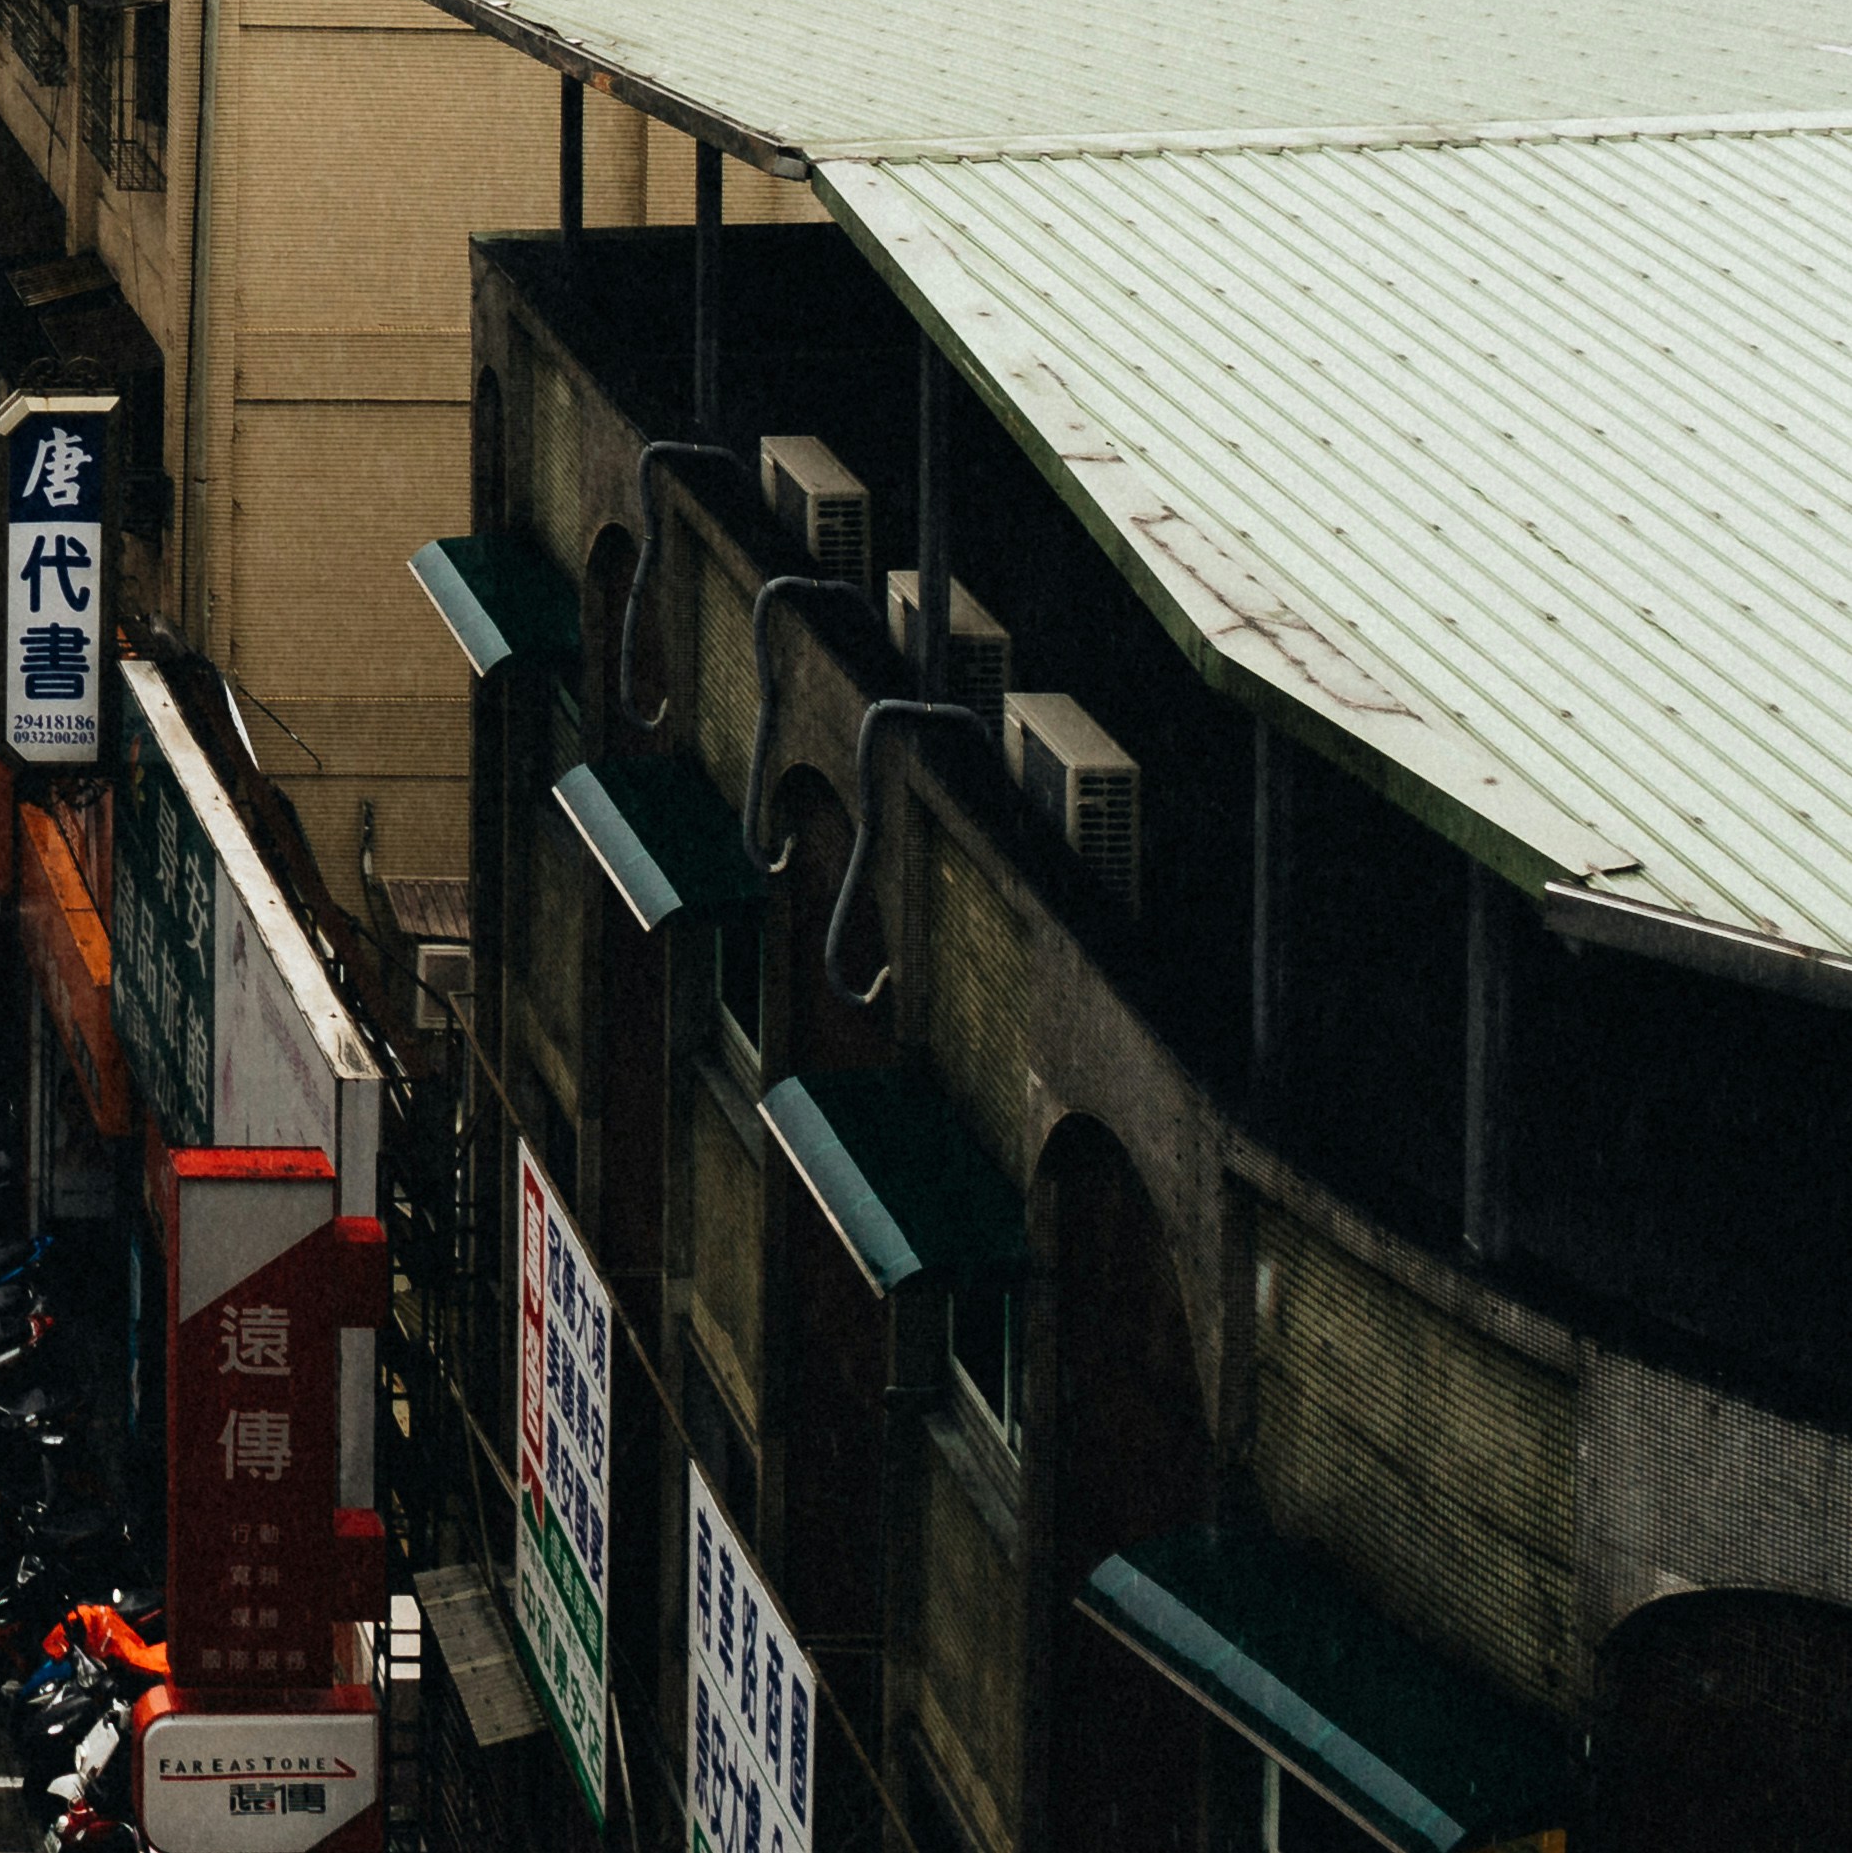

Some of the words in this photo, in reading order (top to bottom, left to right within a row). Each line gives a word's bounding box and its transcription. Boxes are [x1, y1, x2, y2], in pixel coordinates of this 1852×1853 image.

[21, 428, 92, 700] 唐代書
[13, 714, 95, 731] 29418186
[13, 731, 95, 745] 0932200203
[218, 1304, 294, 1482] 遠傳
